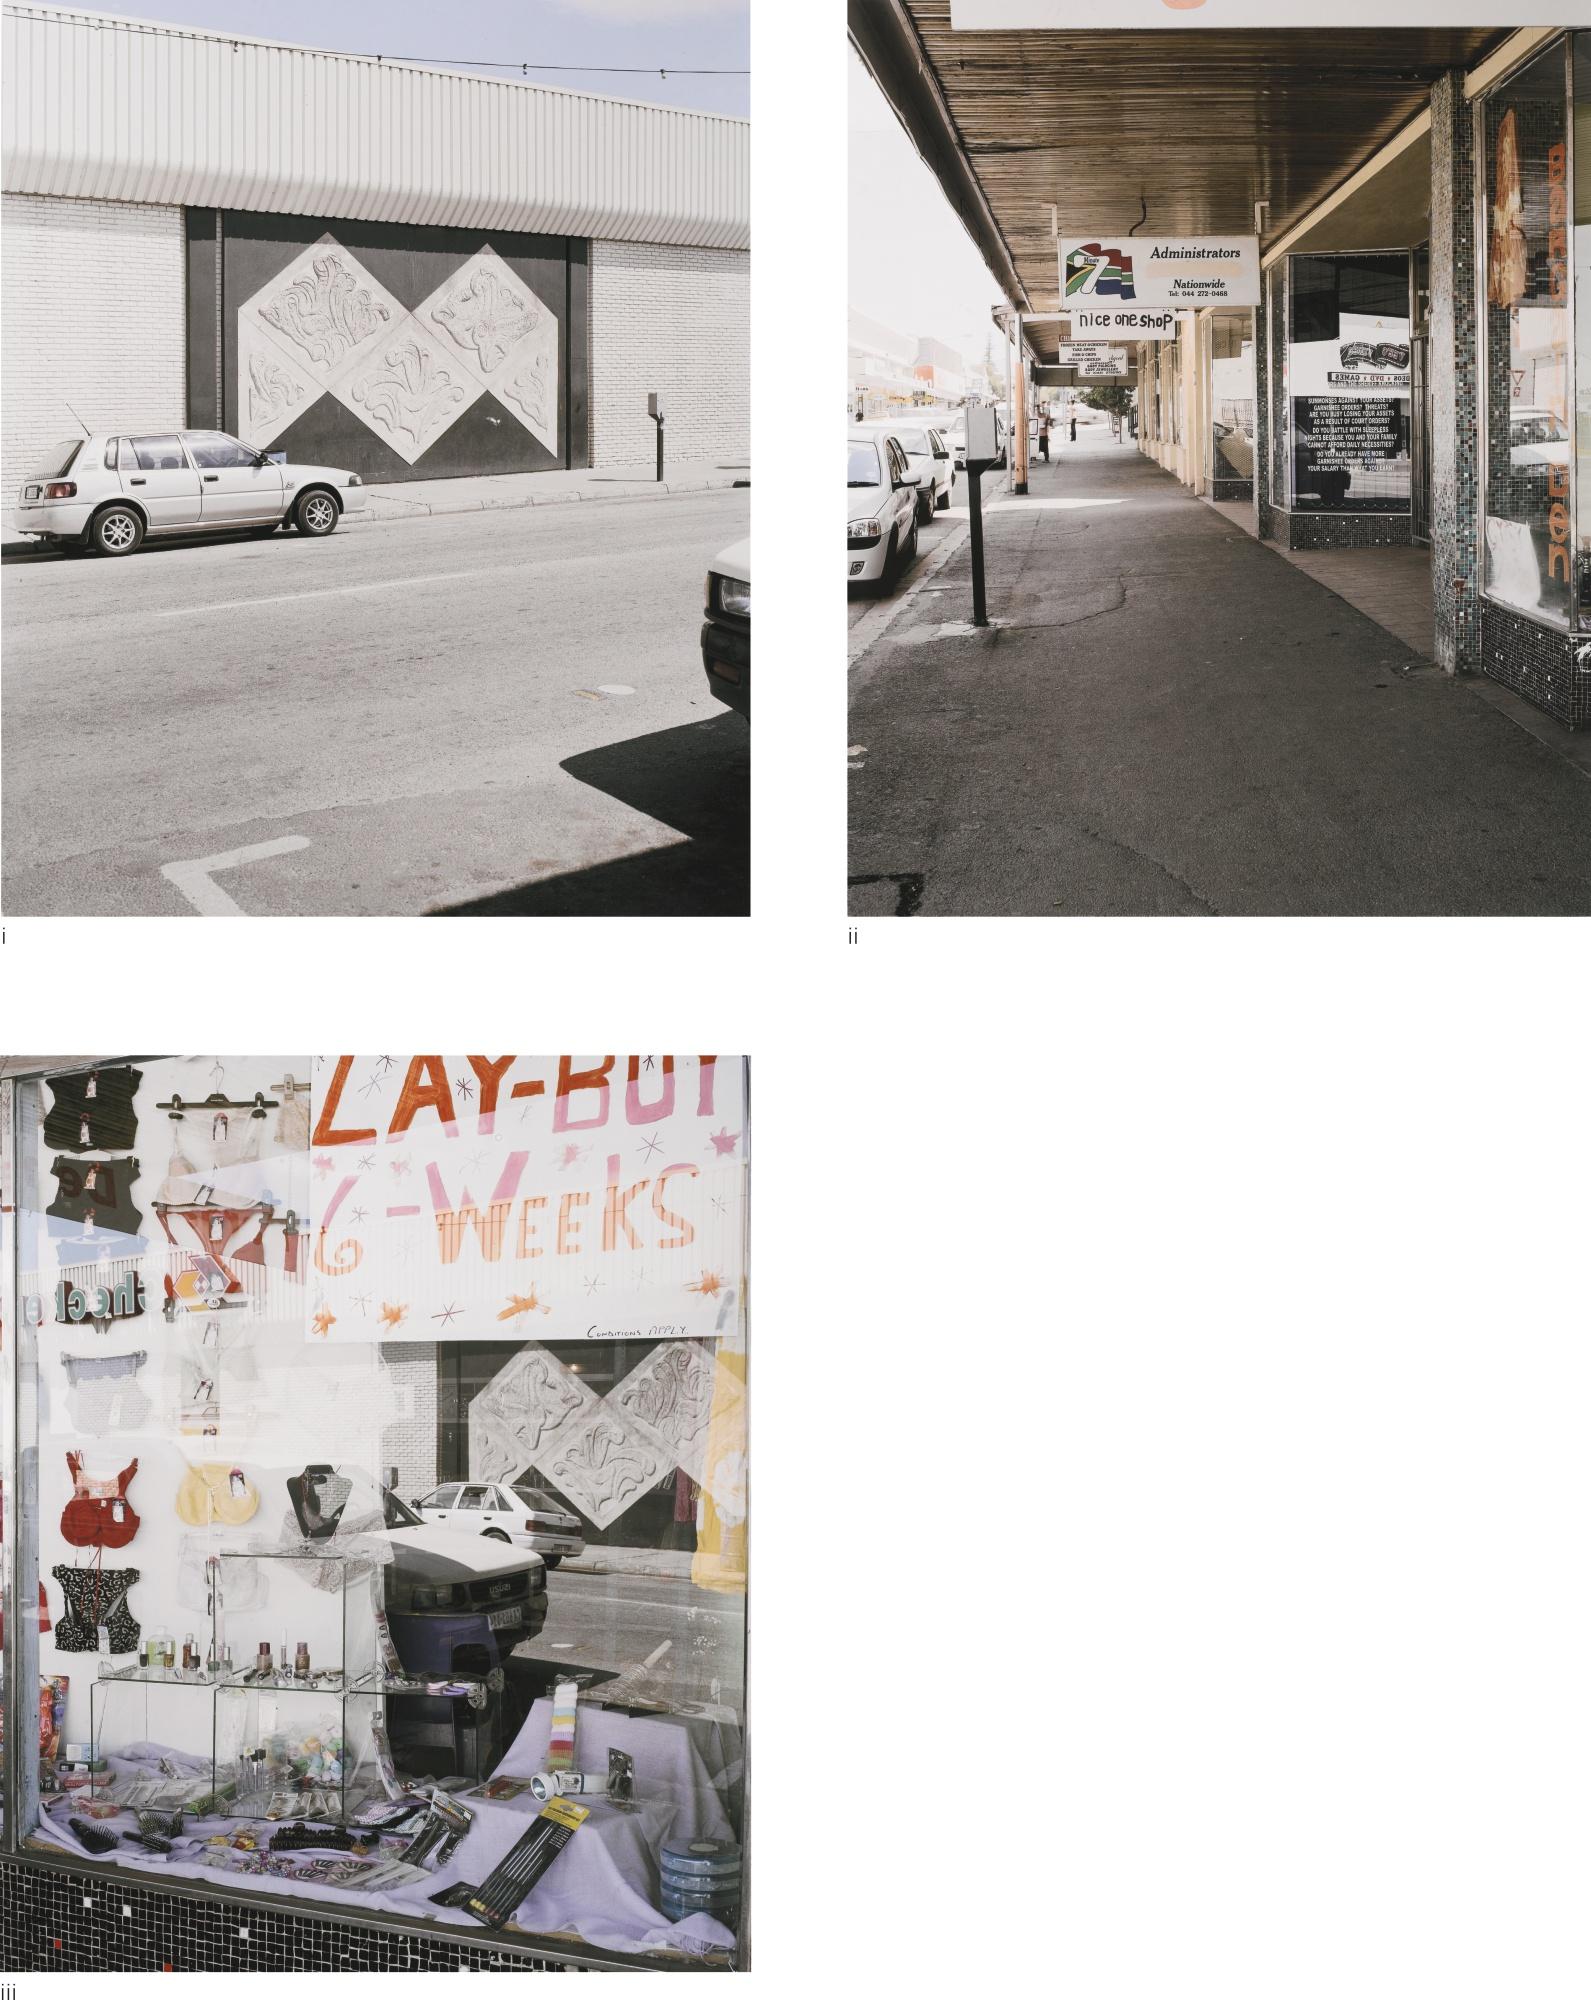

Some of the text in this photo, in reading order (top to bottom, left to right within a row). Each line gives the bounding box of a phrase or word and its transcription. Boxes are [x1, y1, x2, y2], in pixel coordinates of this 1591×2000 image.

[1149, 246, 1241, 259] Administrators
[1173, 278, 1226, 289] Nationwide
[1079, 313, 1111, 327] nice
[1114, 313, 1138, 327] one
